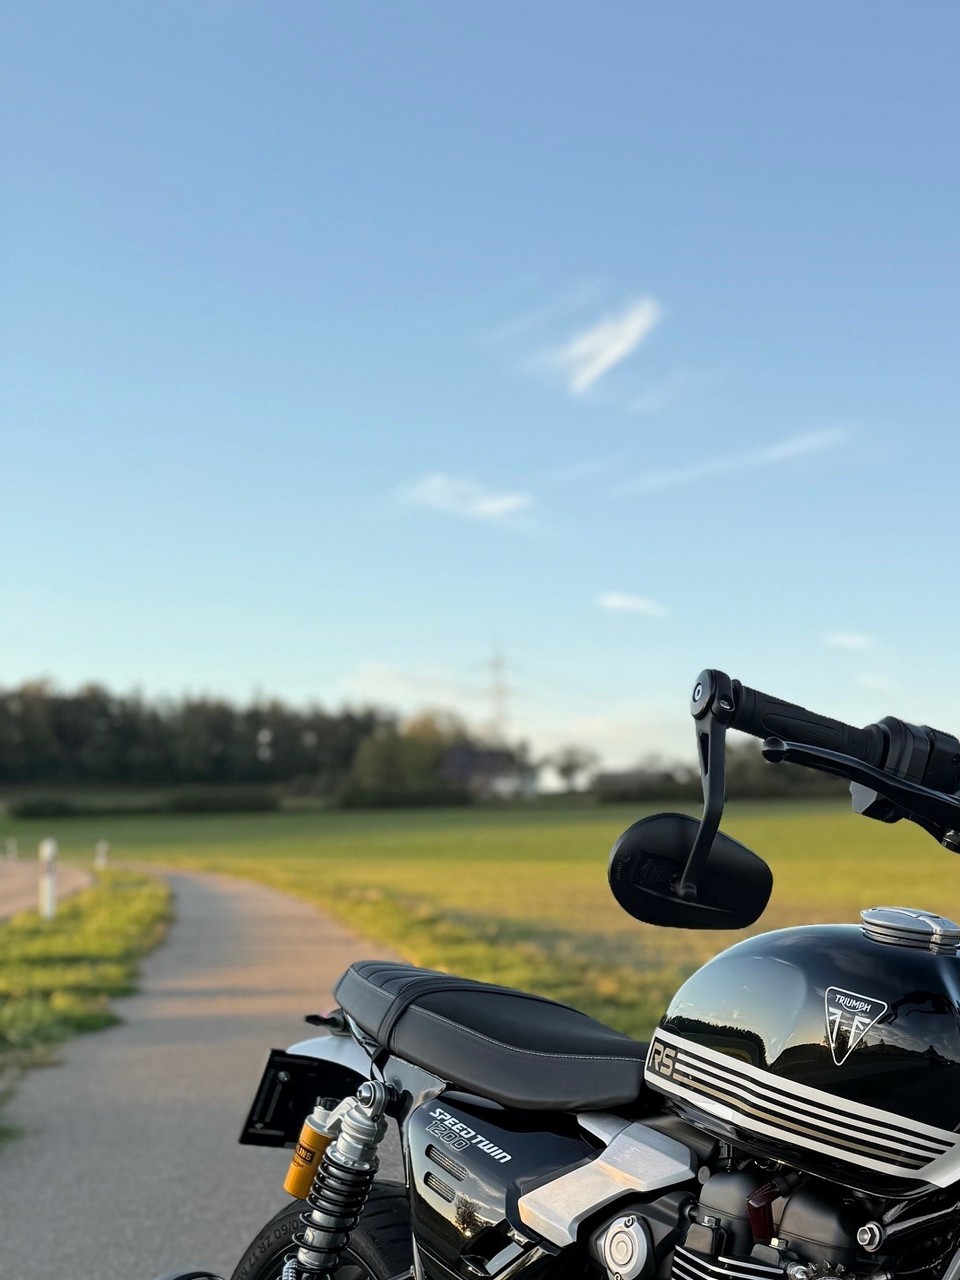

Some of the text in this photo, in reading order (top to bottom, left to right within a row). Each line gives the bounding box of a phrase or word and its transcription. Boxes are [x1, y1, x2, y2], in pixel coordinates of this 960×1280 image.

[835, 993, 872, 1013] TRIUMPH
[648, 1041, 676, 1076] RS
[425, 1120, 471, 1152] 1200
[428, 1108, 512, 1164] SPEED TWIN
